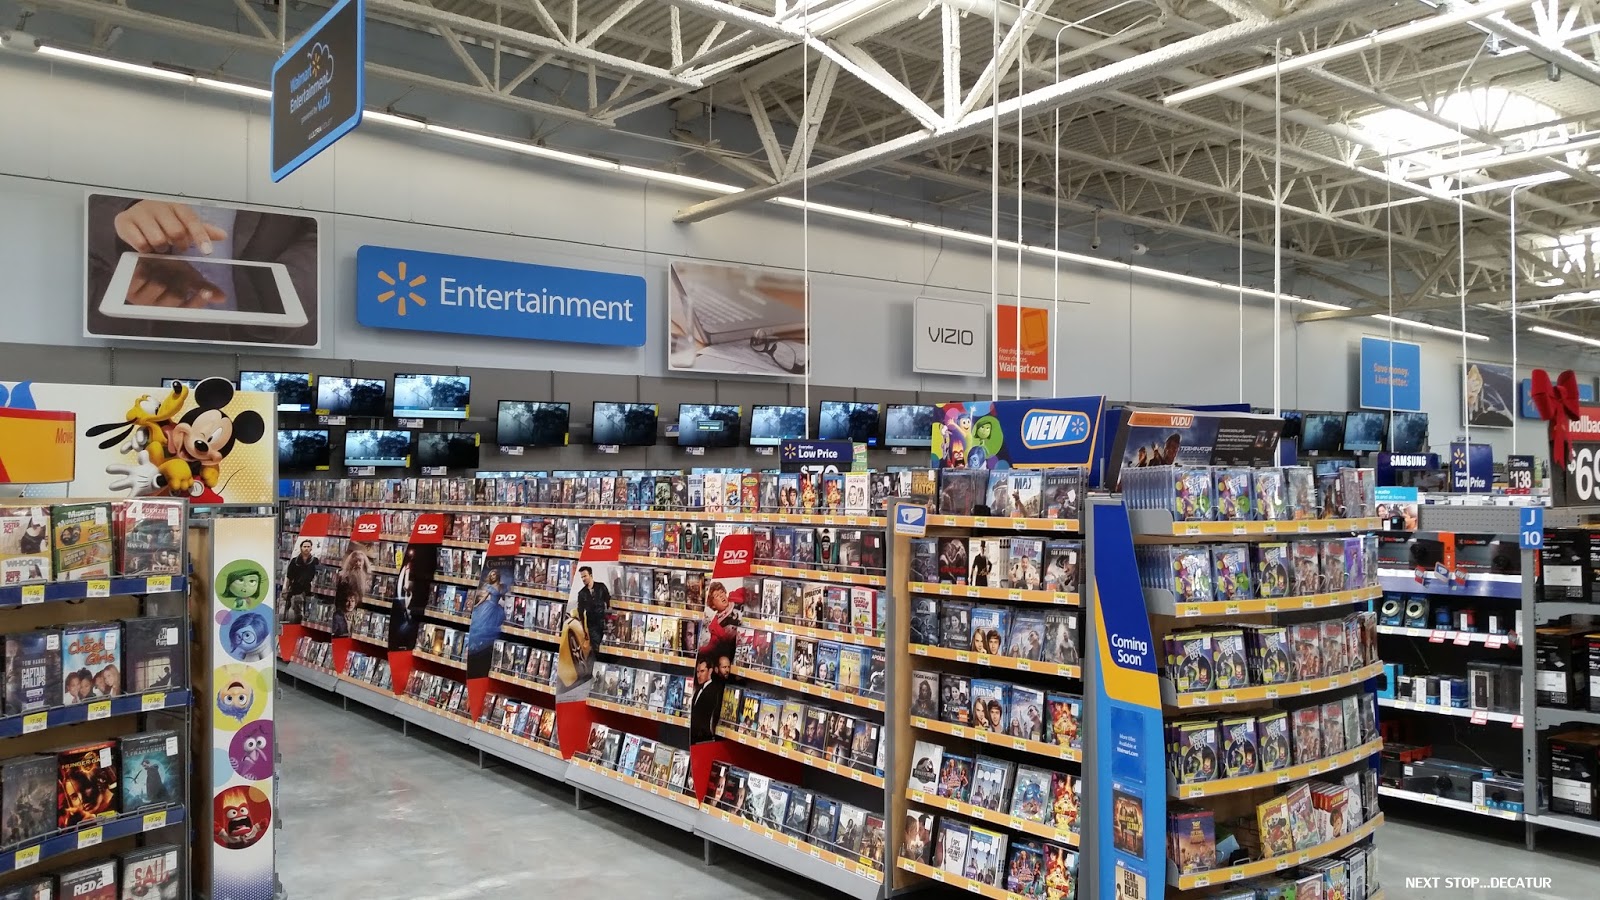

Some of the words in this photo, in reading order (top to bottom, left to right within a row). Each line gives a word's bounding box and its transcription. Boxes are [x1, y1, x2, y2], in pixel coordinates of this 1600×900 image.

[290, 63, 312, 93] Walmart
[290, 69, 328, 114] Entertainment
[440, 277, 633, 322] Entertainment
[928, 327, 973, 346] VIZIO
[1373, 362, 1388, 373] Save
[1375, 374, 1388, 385] Live
[1025, 414, 1072, 440] NEW
[1170, 416, 1191, 426] VUDU
[55, 427, 73, 444] Movie
[798, 449, 816, 459] Low
[817, 449, 838, 459] Price
[1390, 455, 1426, 467] SAMSUNG
[1470, 476, 1486, 488] Price
[1509, 470, 1531, 489] $138
[1526, 510, 1535, 525] J
[417, 523, 438, 531] DVD
[494, 533, 517, 541] DVD
[589, 537, 613, 545] DVD
[1522, 531, 1541, 546] 10
[722, 549, 748, 560] DVD
[736, 644, 752, 655] SPY
[1111, 633, 1147, 656] Coming
[85, 651, 115, 665] Girls
[1117, 649, 1142, 667] Soon
[21, 666, 46, 679] CAPTAIN
[21, 675, 46, 689] PHILLIPS
[1116, 747, 1139, 758] Walmart.com
[1124, 870, 1136, 880] FEAR
[74, 881, 95, 896] RED
[1124, 887, 1139, 900] DEAD
